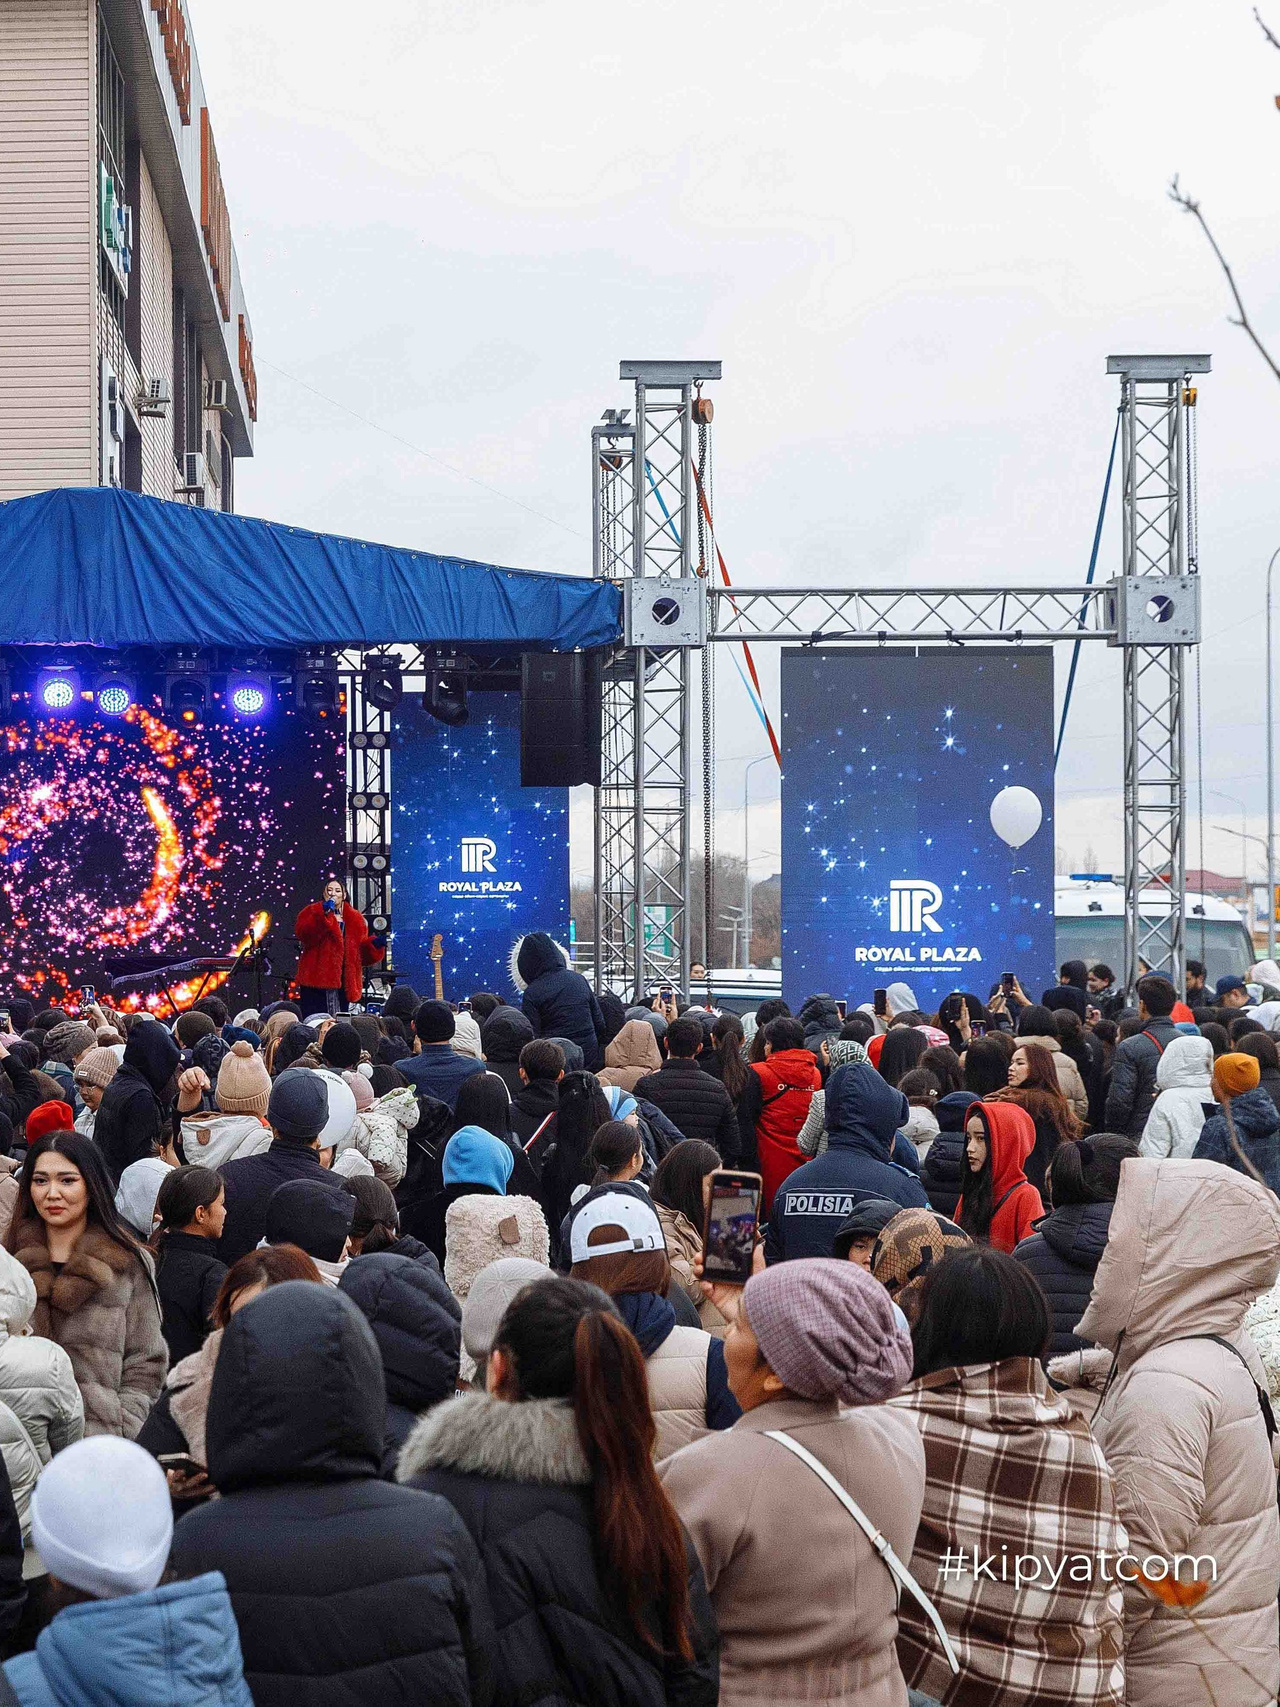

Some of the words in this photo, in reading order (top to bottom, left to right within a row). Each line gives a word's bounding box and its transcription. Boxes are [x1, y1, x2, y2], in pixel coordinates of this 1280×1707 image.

[439, 881, 479, 892] ROYAL
[481, 881, 522, 892] PLAZA
[855, 947, 916, 962] ROYAL
[920, 947, 982, 962] PLAZA
[787, 1196, 854, 1213] POLISIA
